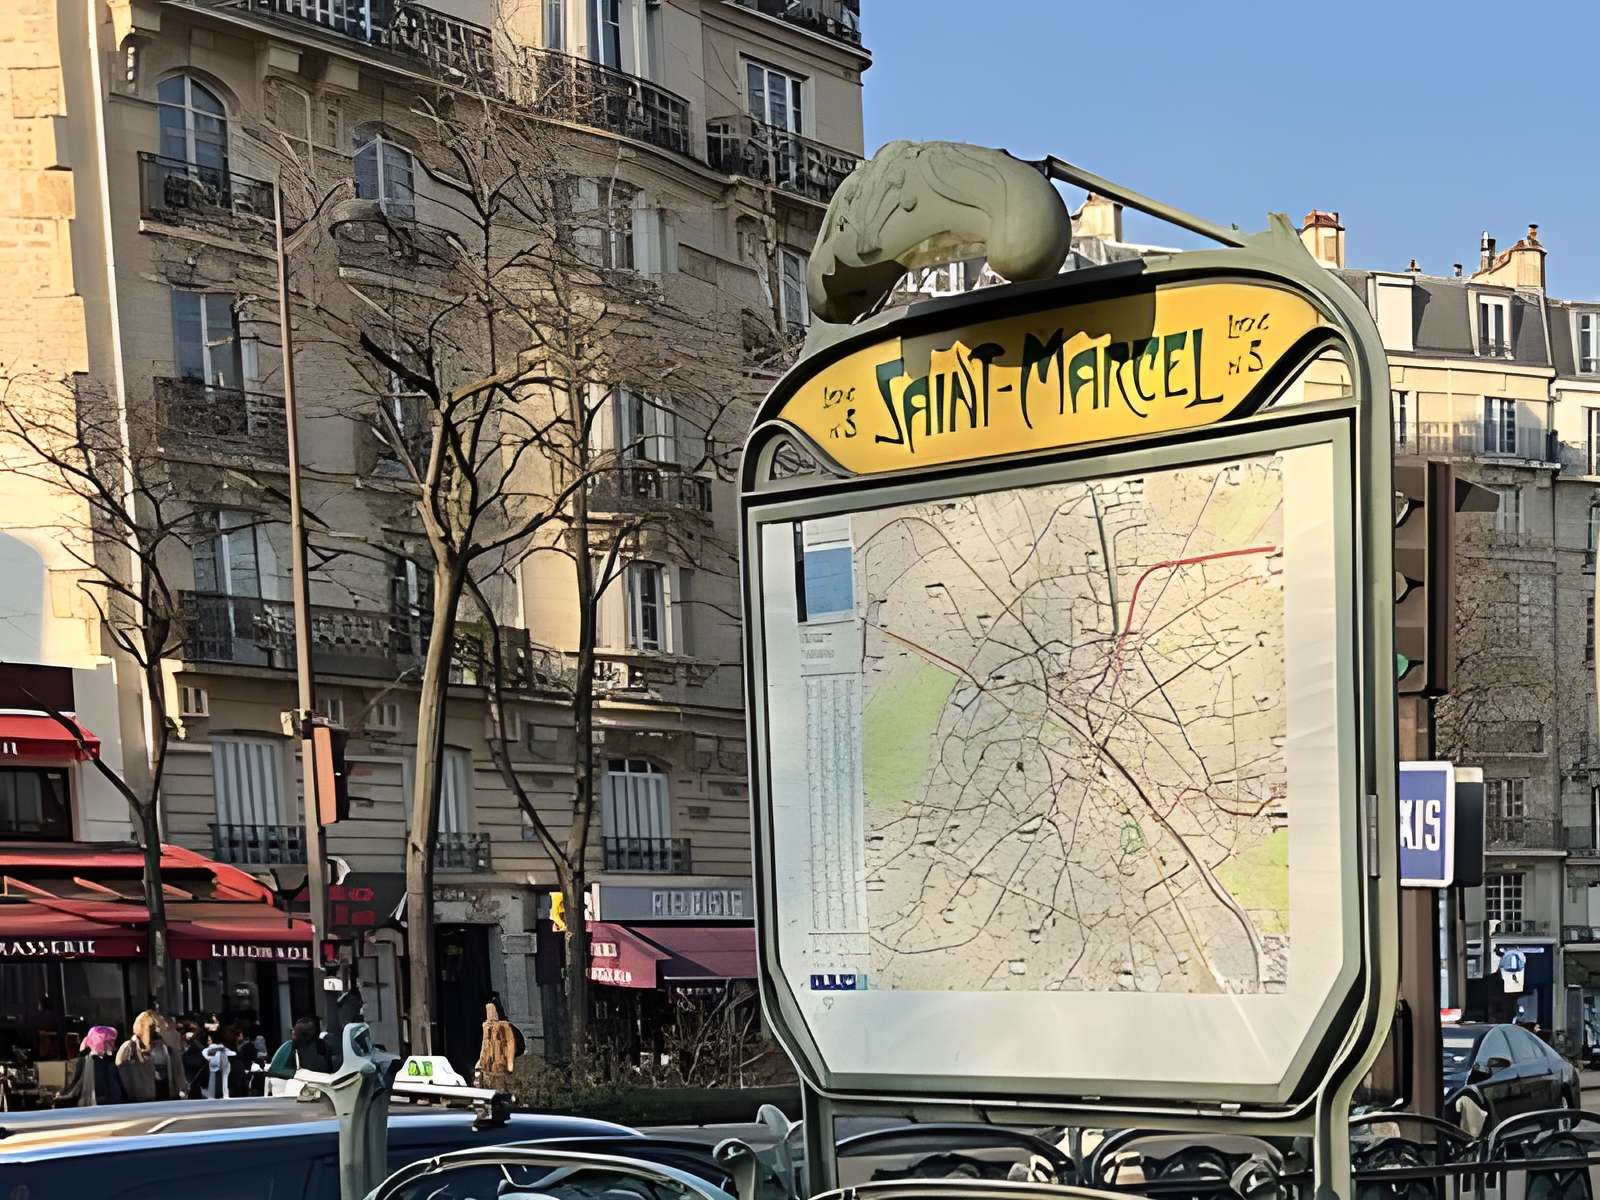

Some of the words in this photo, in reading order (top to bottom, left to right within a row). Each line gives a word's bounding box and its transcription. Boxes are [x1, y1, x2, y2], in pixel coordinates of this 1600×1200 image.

[874, 327, 1224, 454] SAINT-MARCEL
[1400, 799, 1441, 851] XIS
[0, 939, 96, 956] RASSERIE
